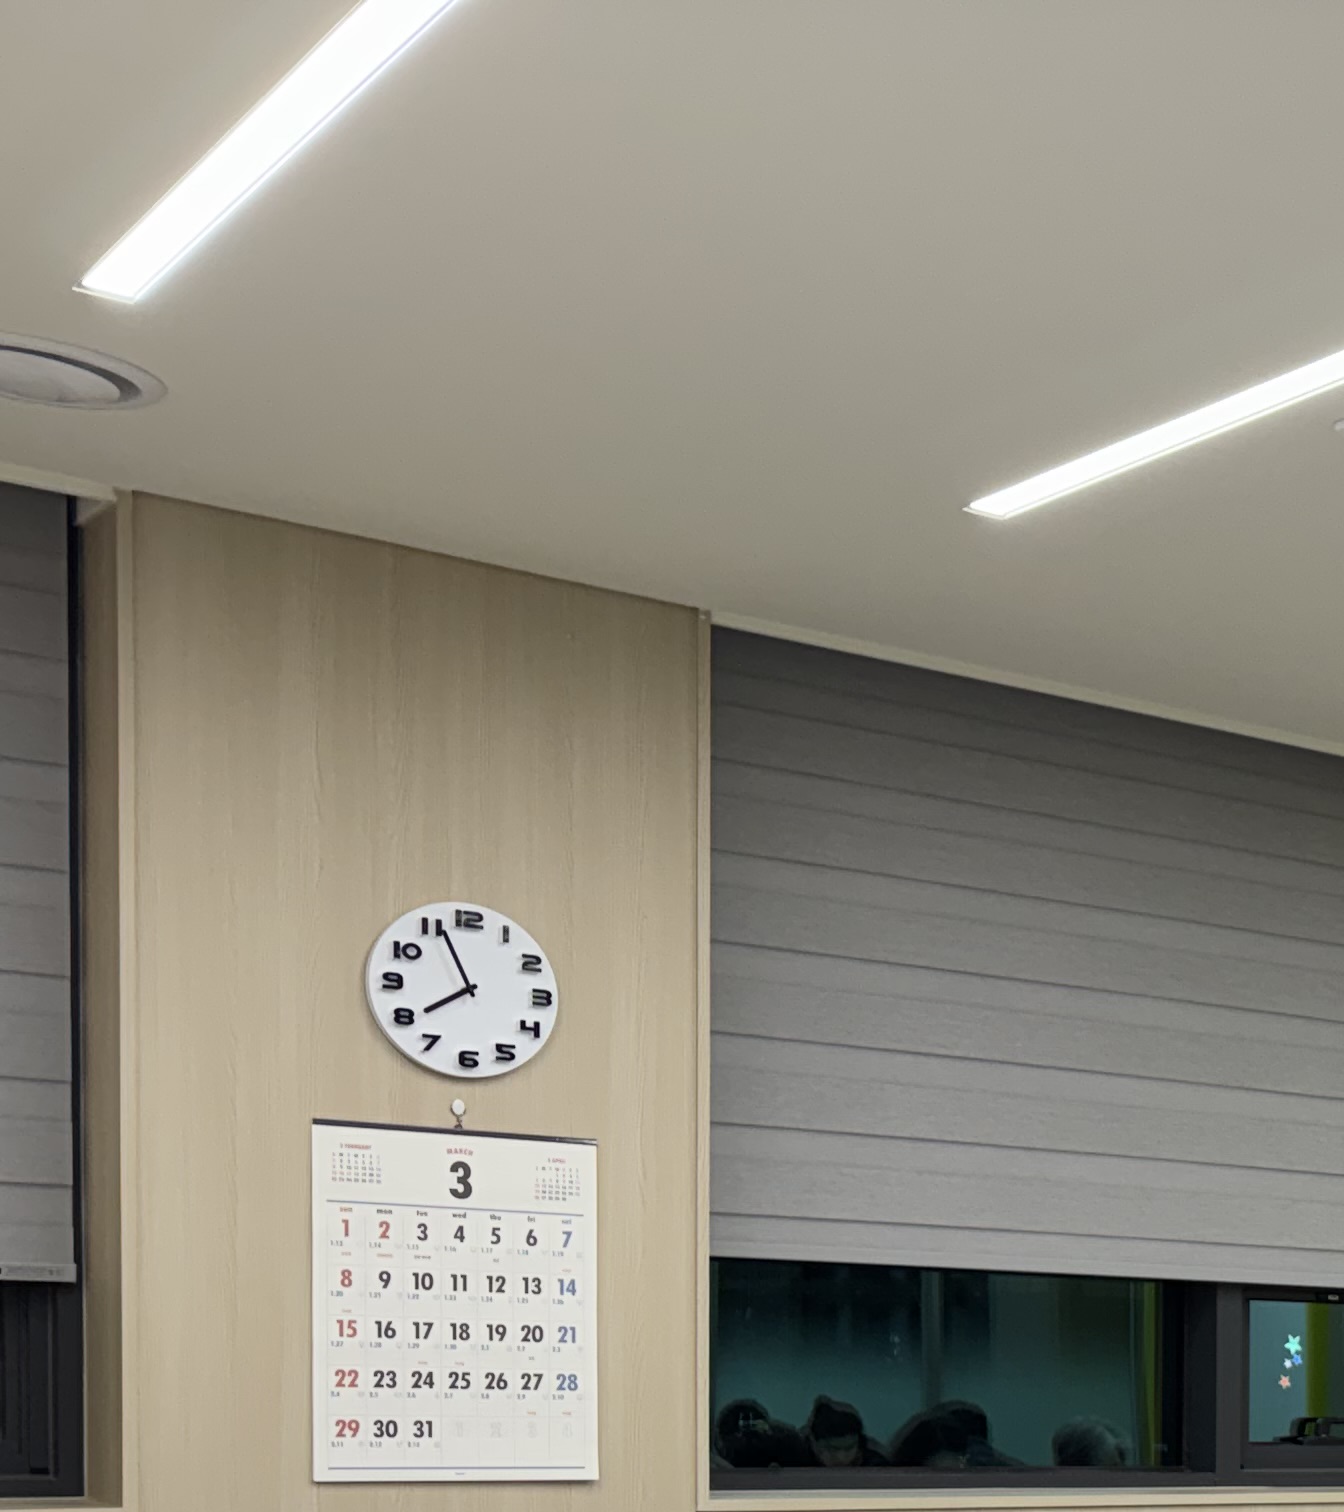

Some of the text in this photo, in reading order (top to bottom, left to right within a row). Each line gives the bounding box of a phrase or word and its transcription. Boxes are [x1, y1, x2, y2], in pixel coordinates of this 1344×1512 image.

[421, 917, 443, 936] 11
[455, 909, 484, 930] 12
[502, 925, 509, 943] 1
[392, 940, 422, 960] 10
[521, 953, 542, 973] 2
[382, 971, 404, 990] 9
[532, 988, 553, 1007] 3
[393, 1007, 415, 1025] 8
[519, 1019, 541, 1038] 4
[421, 1033, 442, 1051] 7
[458, 1050, 479, 1068] 6
[495, 1043, 516, 1061] 5
[446, 1148, 474, 1156] MARCH
[449, 1160, 473, 1200] 3
[342, 1219, 572, 1247] 1 2 3 4 5 6 7
[341, 1269, 576, 1296] 8 9 10 11 12 13 14
[337, 1320, 575, 1343] 15 16 17 18 19 20 21
[335, 1369, 578, 1391] 22 23 24 25 26 27 28
[335, 1420, 432, 1438] 29 30 31
